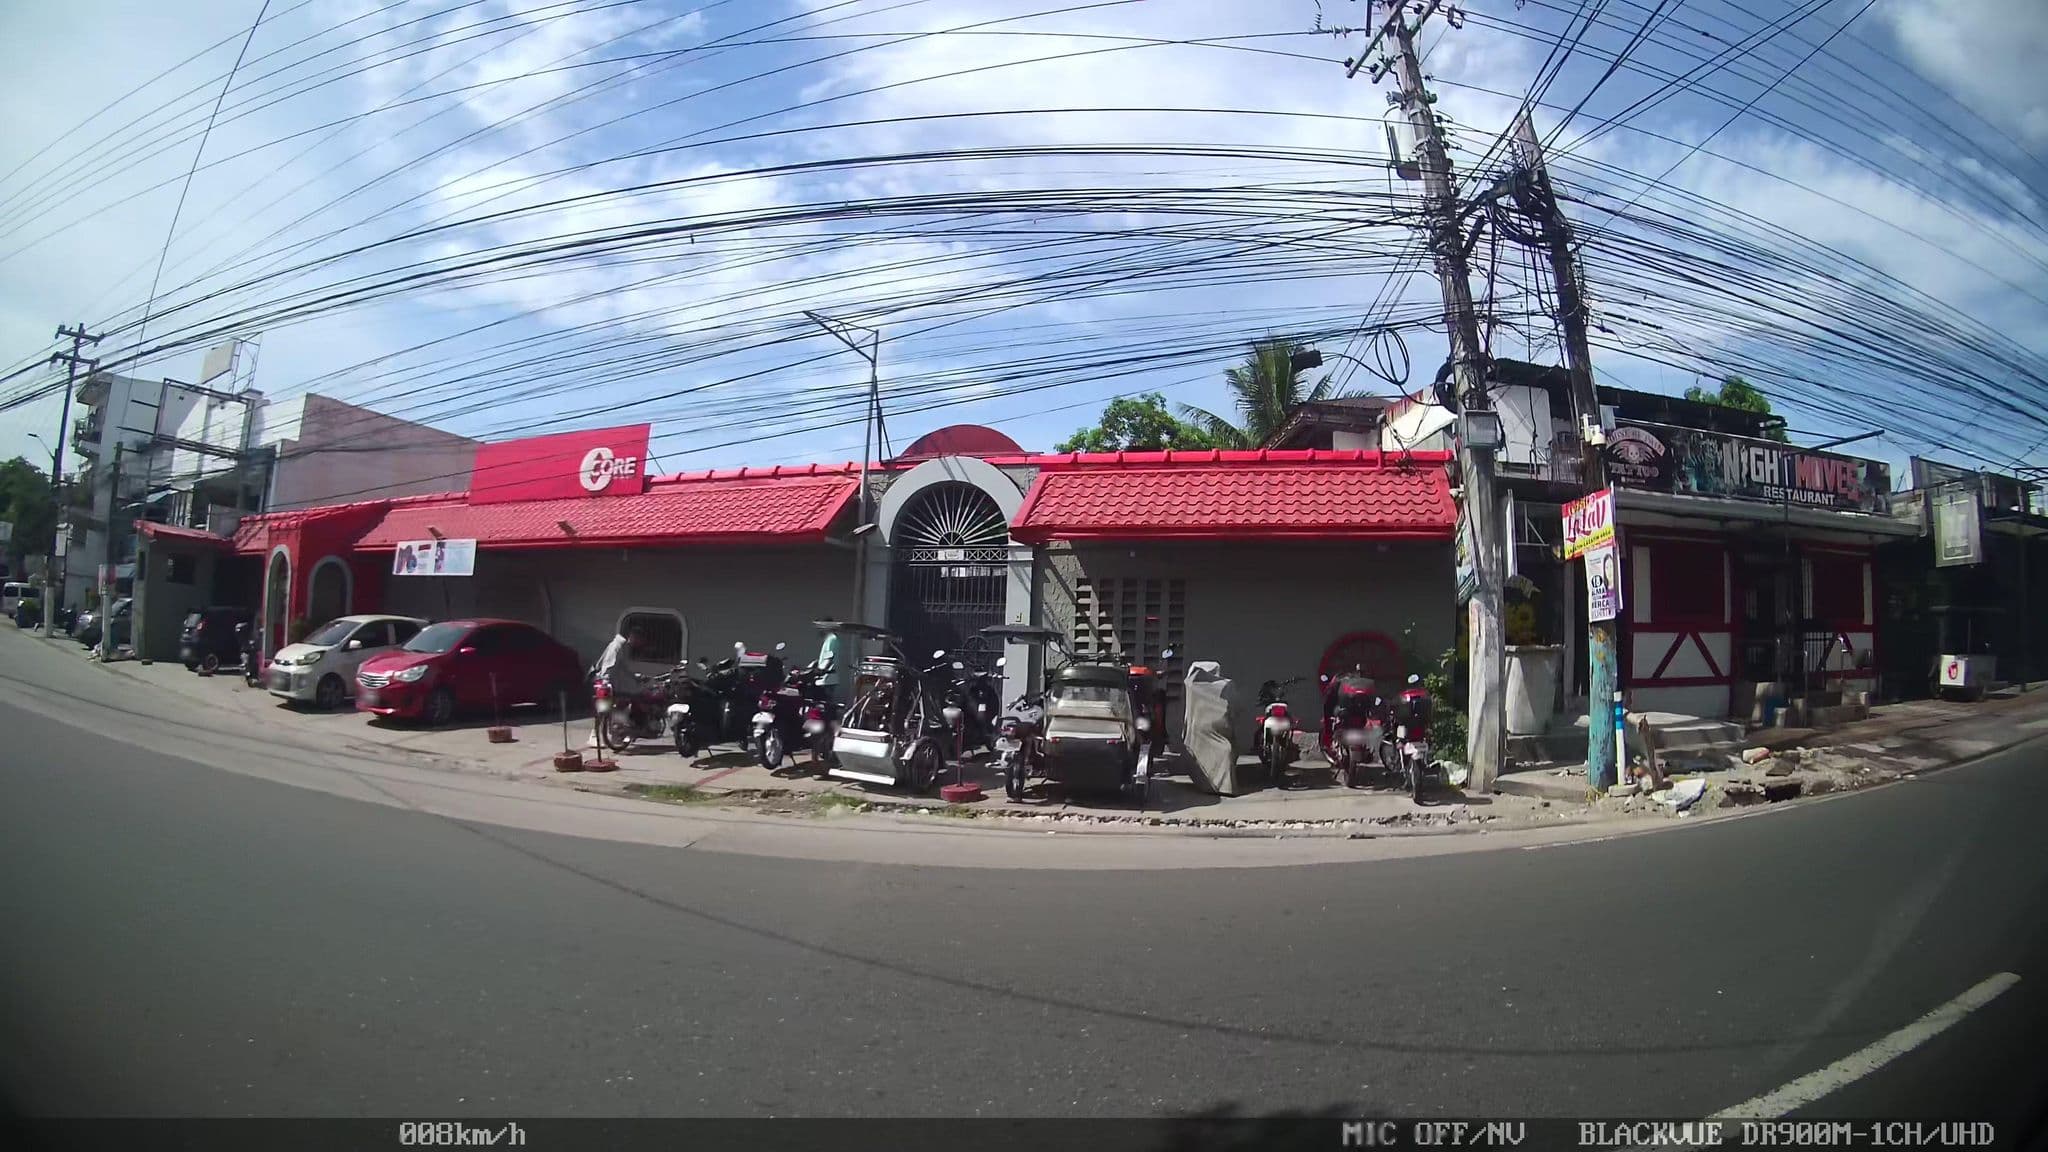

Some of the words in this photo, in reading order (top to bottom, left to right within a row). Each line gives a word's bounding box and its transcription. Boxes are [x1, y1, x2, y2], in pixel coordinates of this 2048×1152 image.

[1723, 439, 1792, 488] NIGHT
[1794, 454, 1861, 502] MOVES
[1763, 485, 1835, 506] RESTAURANT
